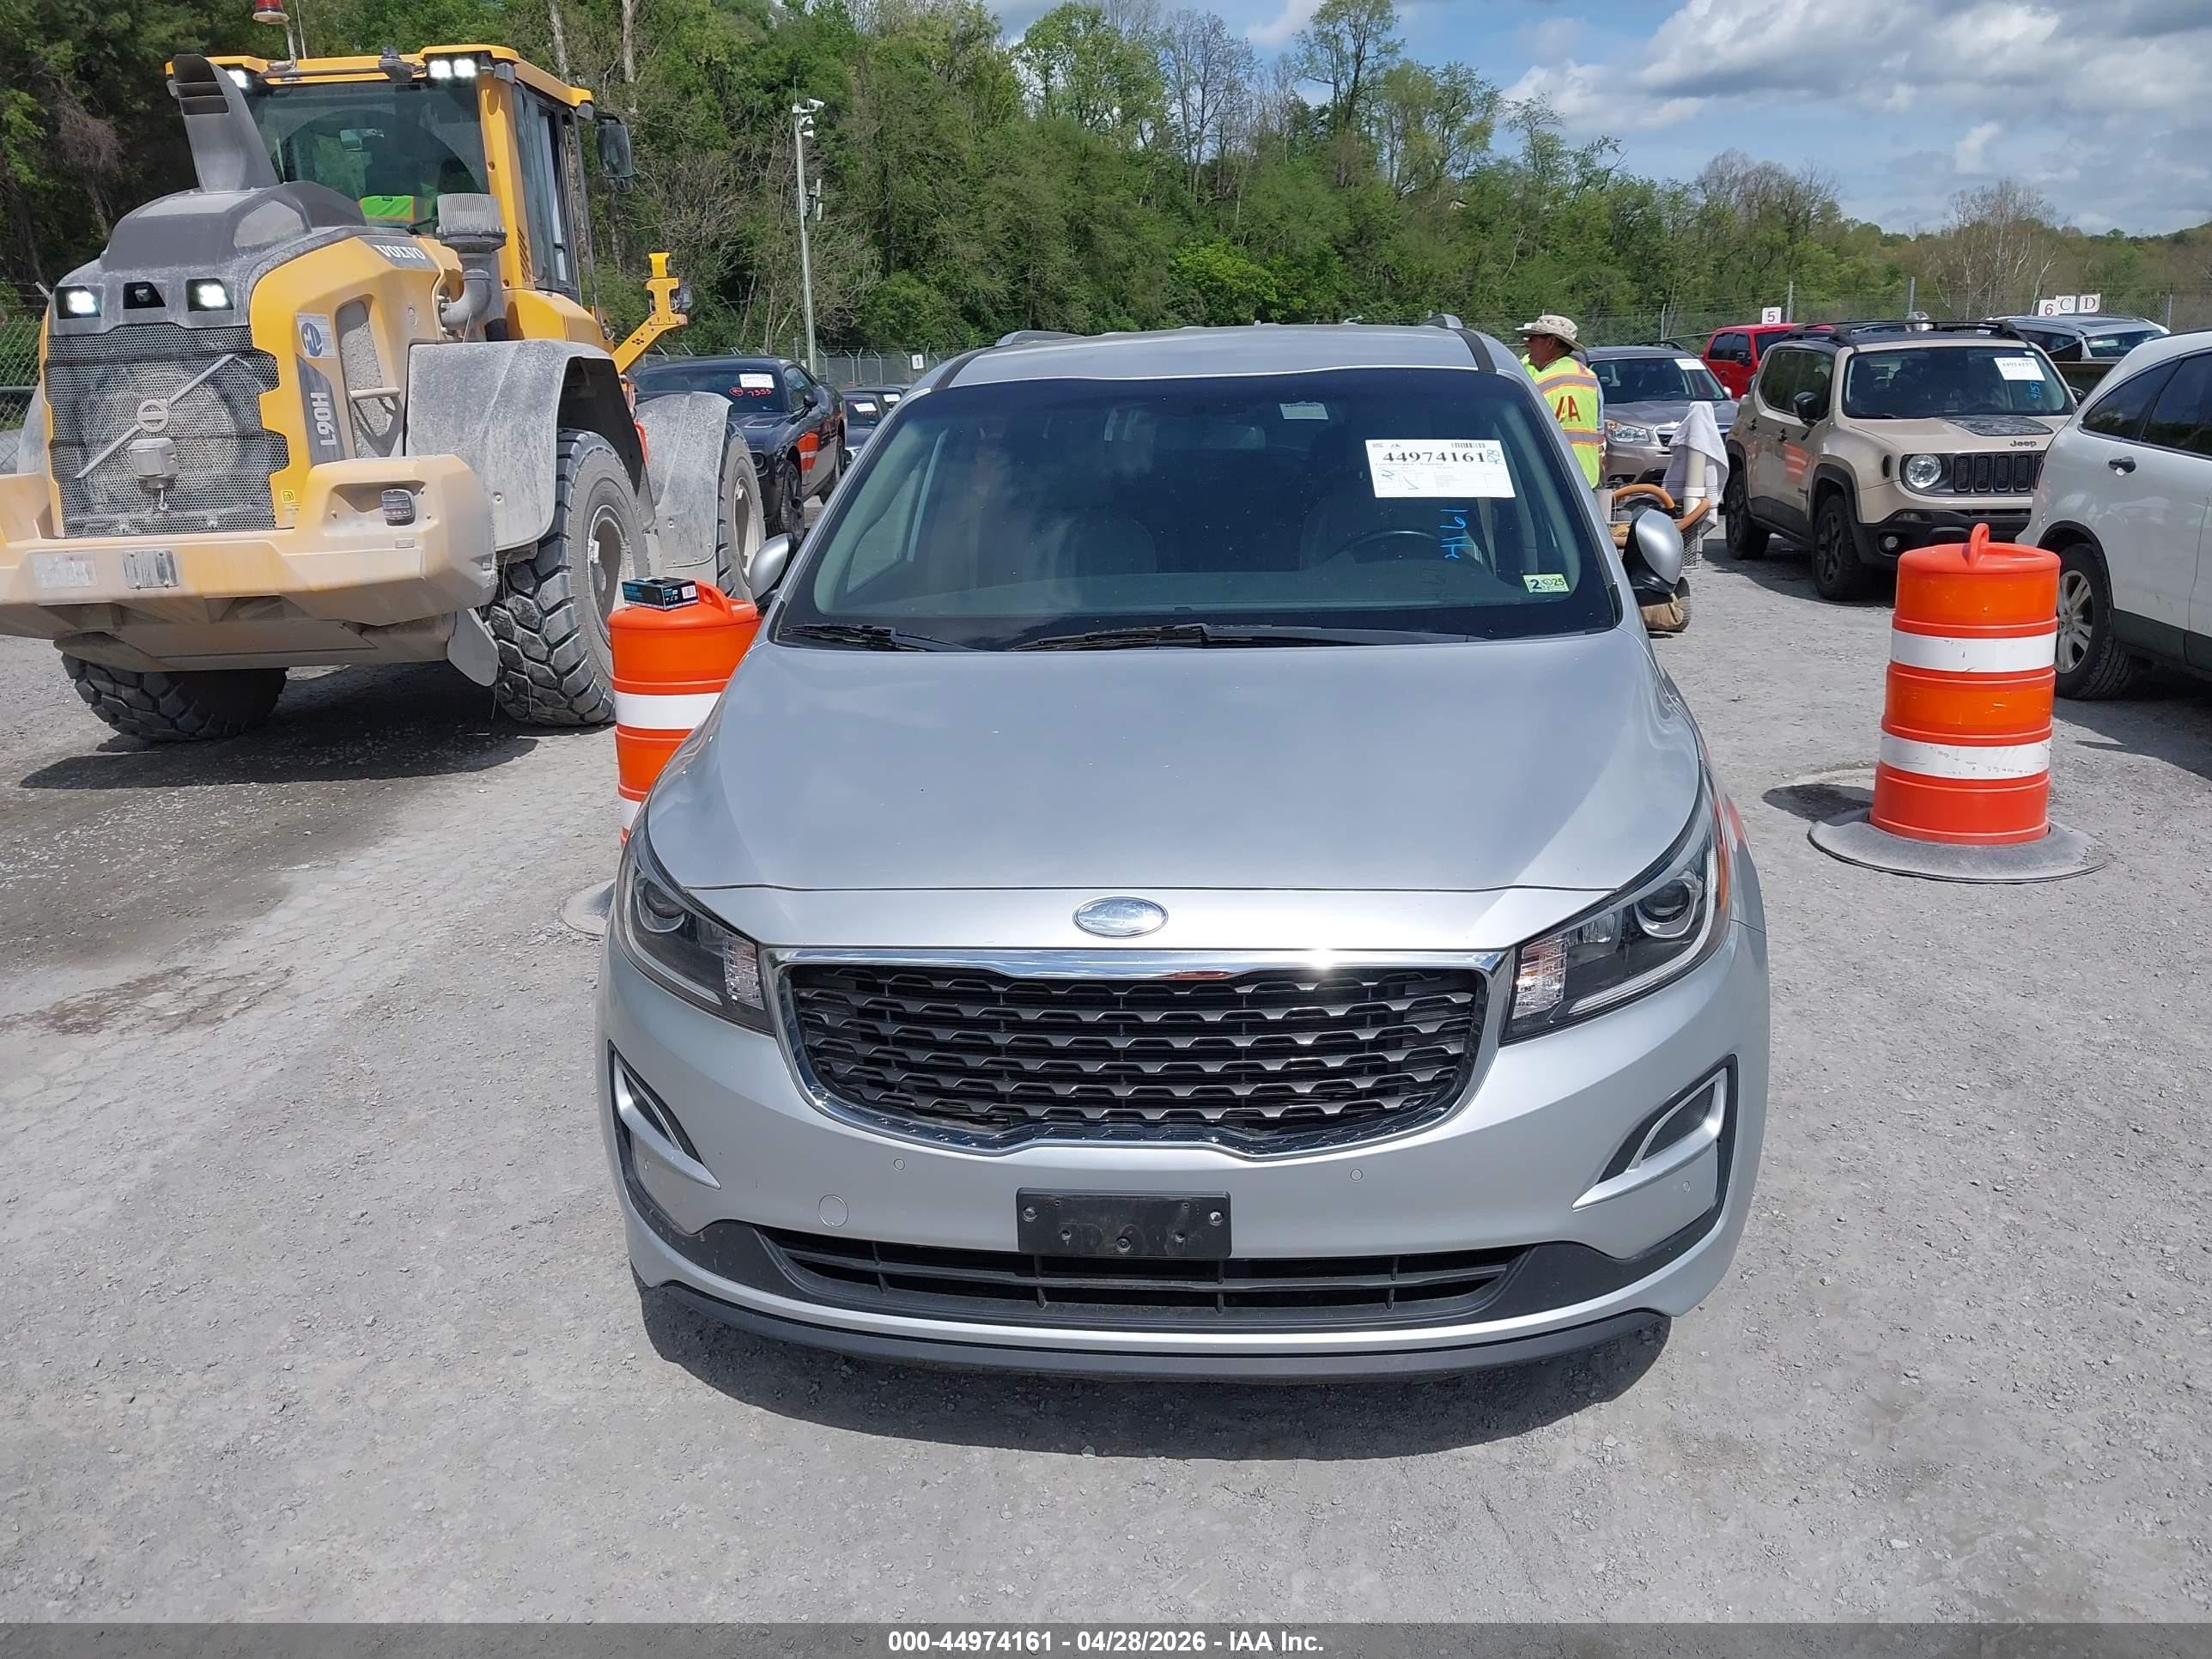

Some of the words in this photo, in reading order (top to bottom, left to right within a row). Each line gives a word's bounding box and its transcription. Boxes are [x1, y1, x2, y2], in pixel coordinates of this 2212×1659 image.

[371, 245, 427, 260] VOLVO
[2060, 297, 2071, 310] C
[2083, 297, 2096, 309] D
[2045, 303, 2055, 316] 6
[1767, 311, 1776, 322] 5
[310, 392, 337, 446] L90H
[1382, 452, 1485, 463] 44974161
[1530, 579, 1542, 589] 2
